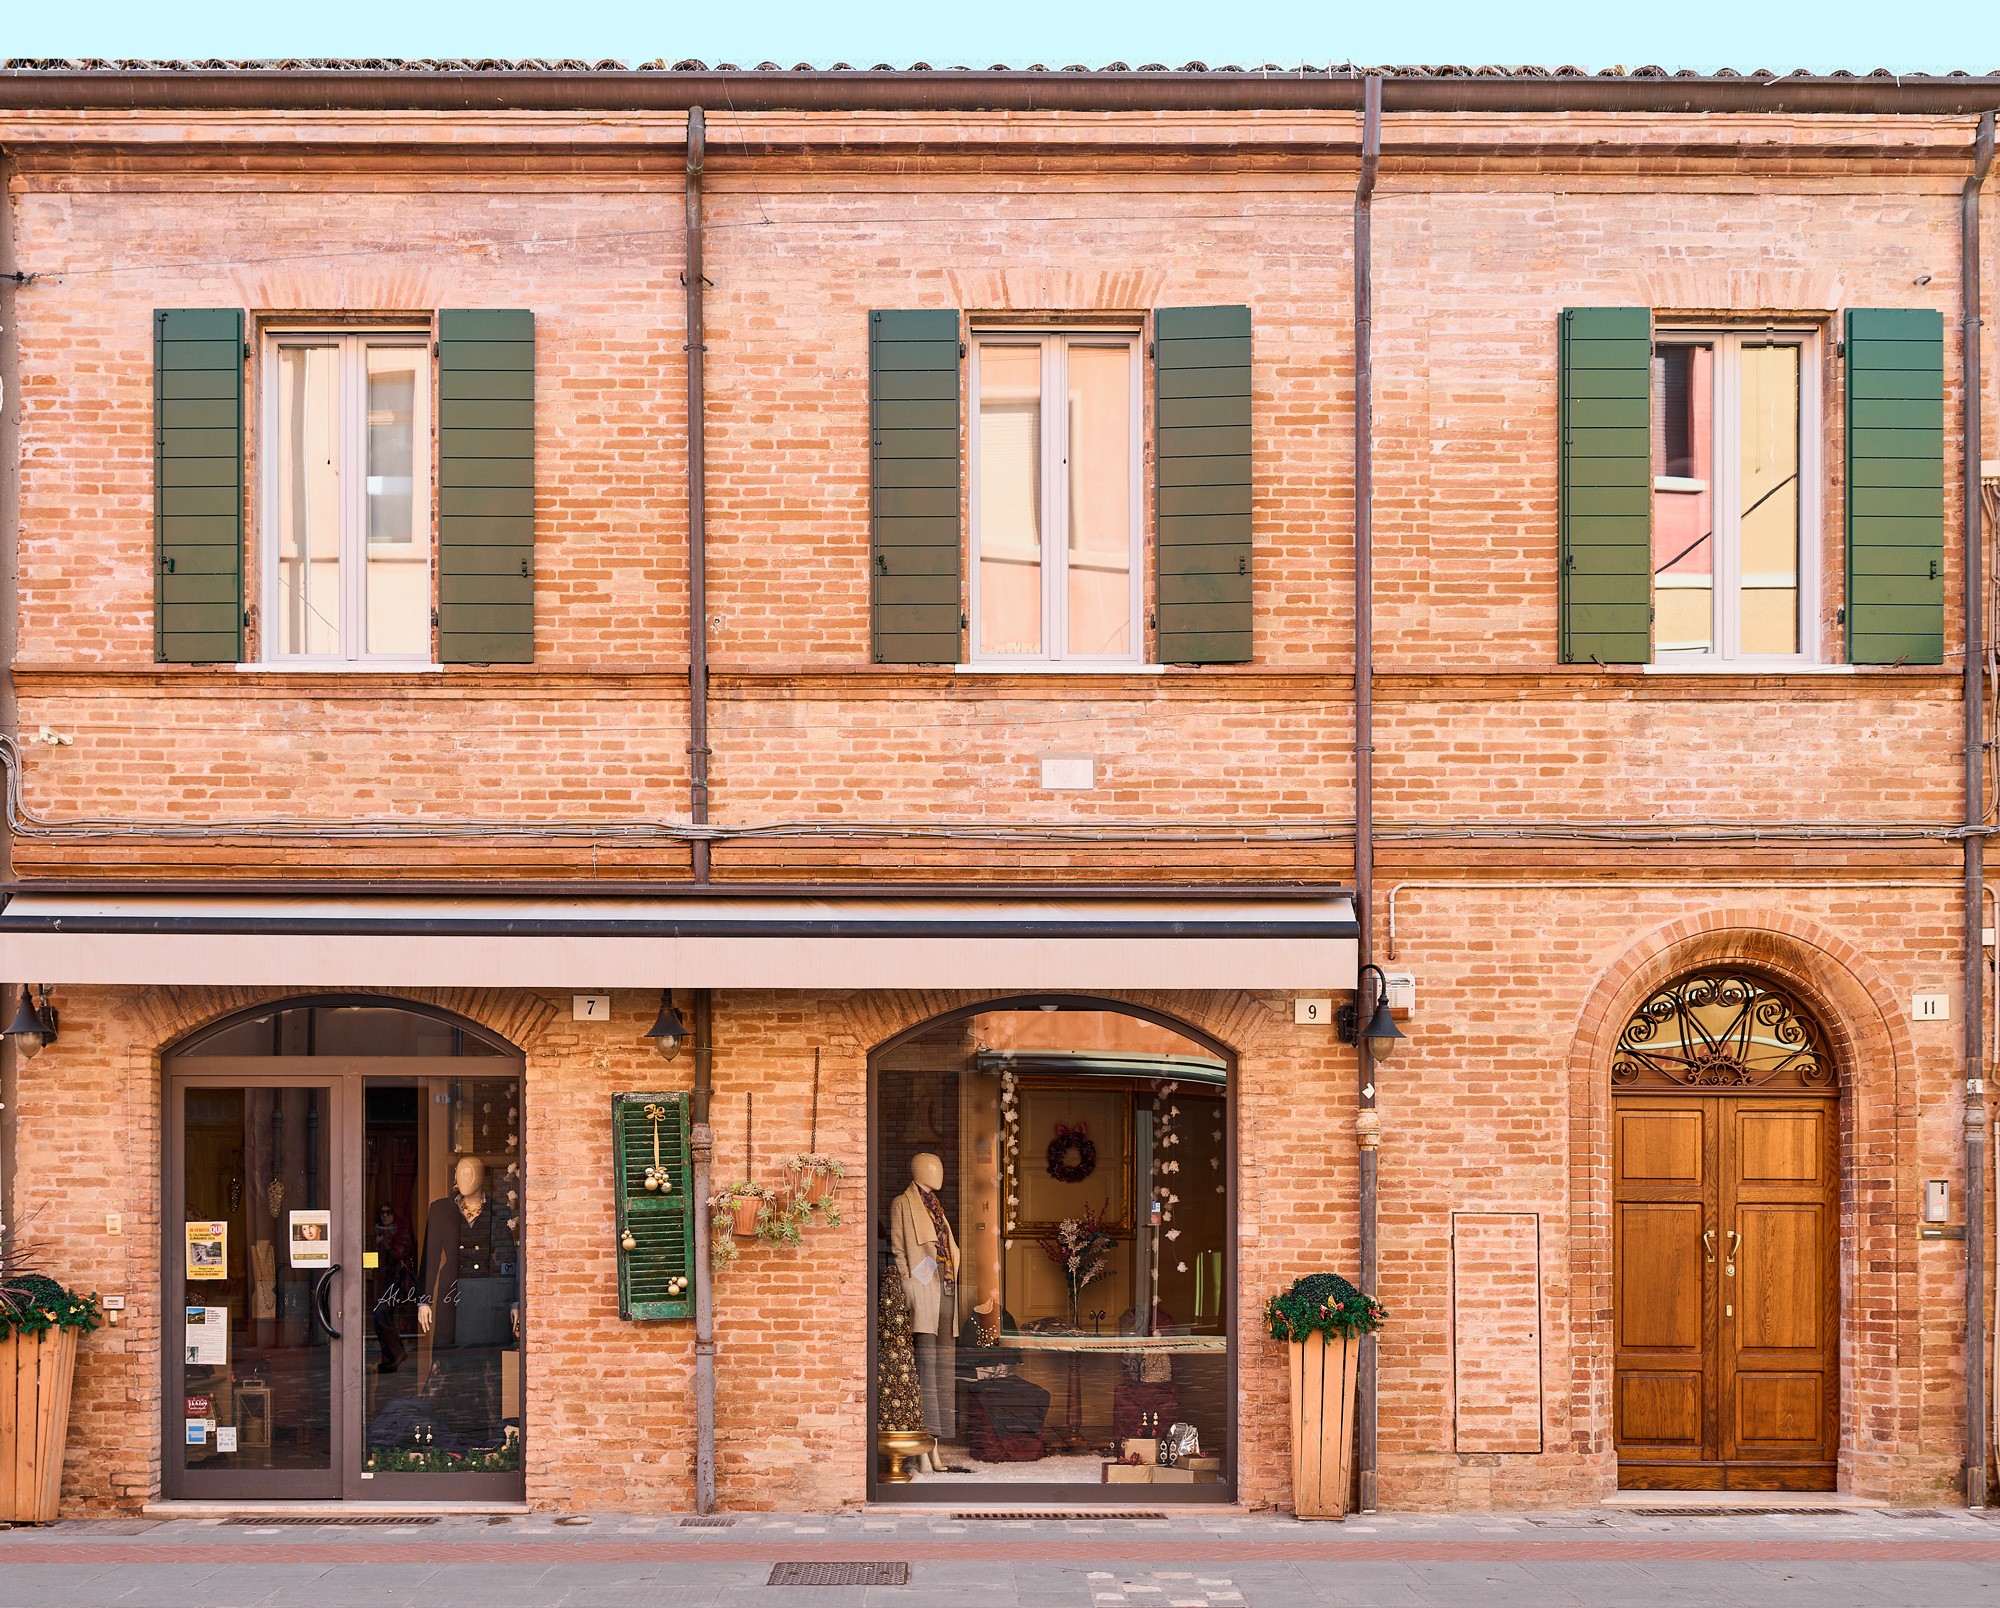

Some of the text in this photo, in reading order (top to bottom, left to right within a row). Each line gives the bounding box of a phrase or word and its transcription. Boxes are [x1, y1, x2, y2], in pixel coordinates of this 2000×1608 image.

[587, 1000, 596, 1015] 7
[1308, 1004, 1317, 1020] 9
[1924, 1000, 1935, 1015] 11
[210, 1226, 223, 1234] QUI
[372, 1282, 435, 1312] Atelier
